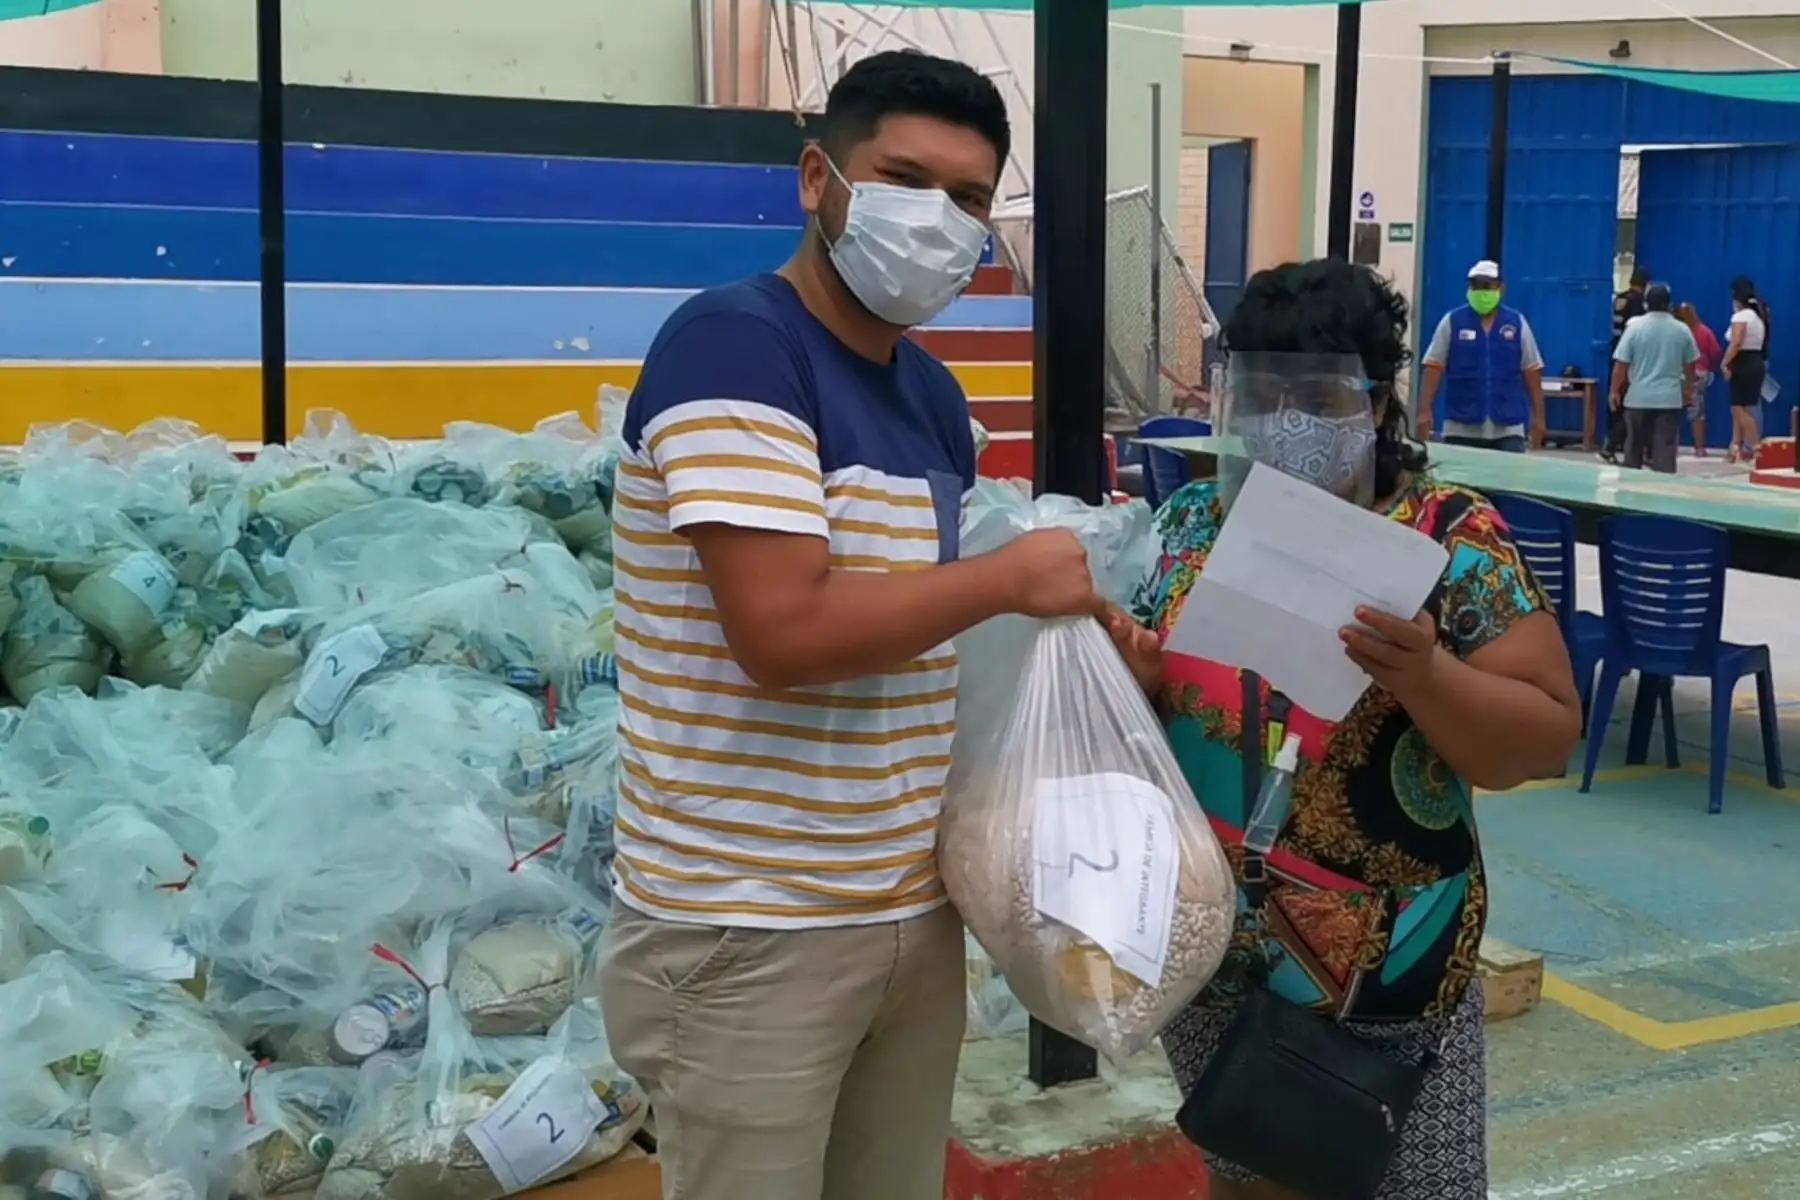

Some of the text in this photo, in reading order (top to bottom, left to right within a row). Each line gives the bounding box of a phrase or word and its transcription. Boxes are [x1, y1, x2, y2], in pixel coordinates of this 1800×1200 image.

[325, 654, 347, 678] 2
[1068, 849, 1119, 879] 2
[536, 1111, 565, 1144] 2
